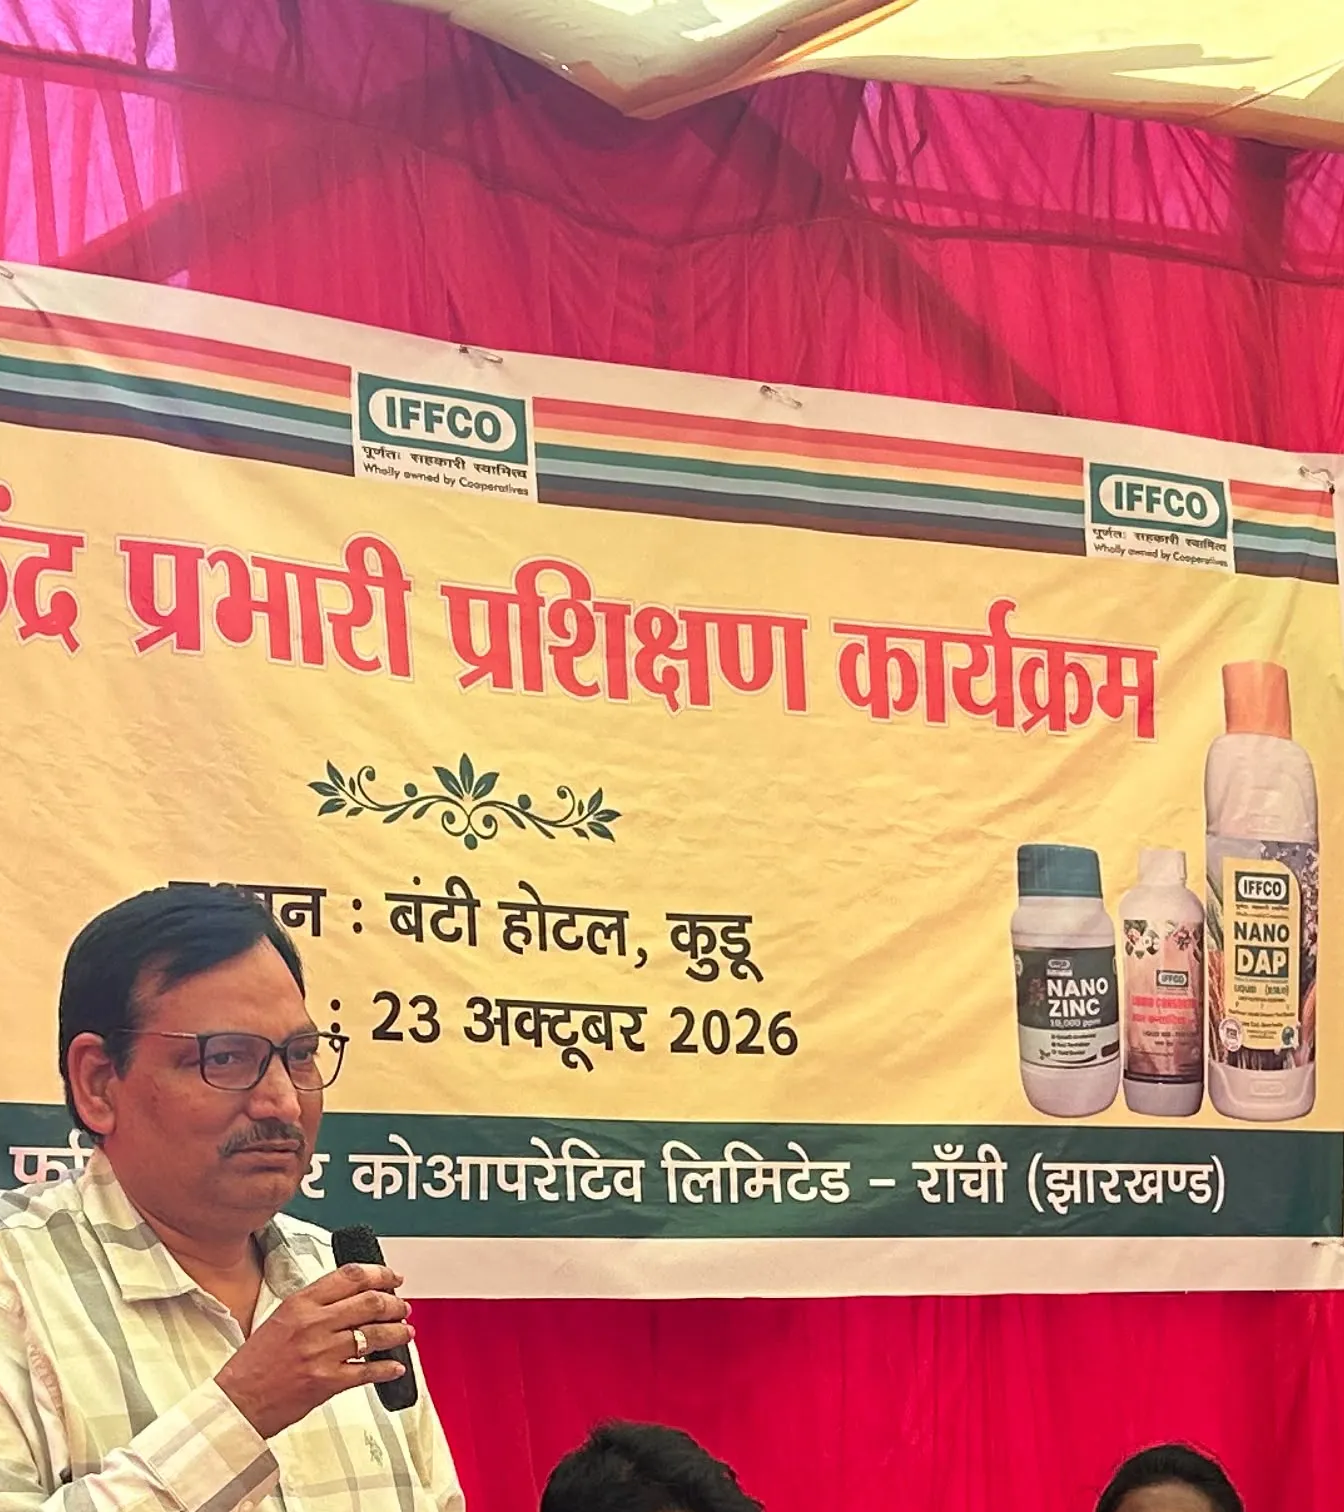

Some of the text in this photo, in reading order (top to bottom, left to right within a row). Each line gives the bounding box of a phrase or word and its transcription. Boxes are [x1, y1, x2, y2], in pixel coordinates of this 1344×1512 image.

[386, 396, 501, 443] IFFCO
[410, 452, 465, 470] सहकारी
[363, 462, 528, 496] Wholly owned by Cooperatives
[1115, 481, 1207, 520] IFFCO
[1093, 543, 1125, 556] Wholly
[1161, 549, 1170, 561] by
[119, 535, 413, 678] प्रभारी
[441, 558, 808, 715] प्रशिक्षण
[833, 598, 1158, 740] कार्यक्रम
[1244, 879, 1281, 896] IFFCO
[386, 875, 481, 947] बंटी
[498, 881, 649, 968] होटल,
[665, 911, 763, 982] कुडू
[1234, 921, 1290, 943] NANO
[1237, 948, 1287, 975] DAP
[1047, 977, 1108, 997] NANO
[1048, 998, 1100, 1017] ZINC
[372, 991, 441, 1044] 23
[464, 996, 647, 1071] अक्टूबर
[669, 1007, 799, 1055] 2026
[347, 1133, 645, 1204] कोआपरेटिव
[660, 1141, 852, 1206] लिमिटेड
[913, 1141, 1006, 1205] राँची
[1026, 1153, 1226, 1214] (झारखण्ड)
